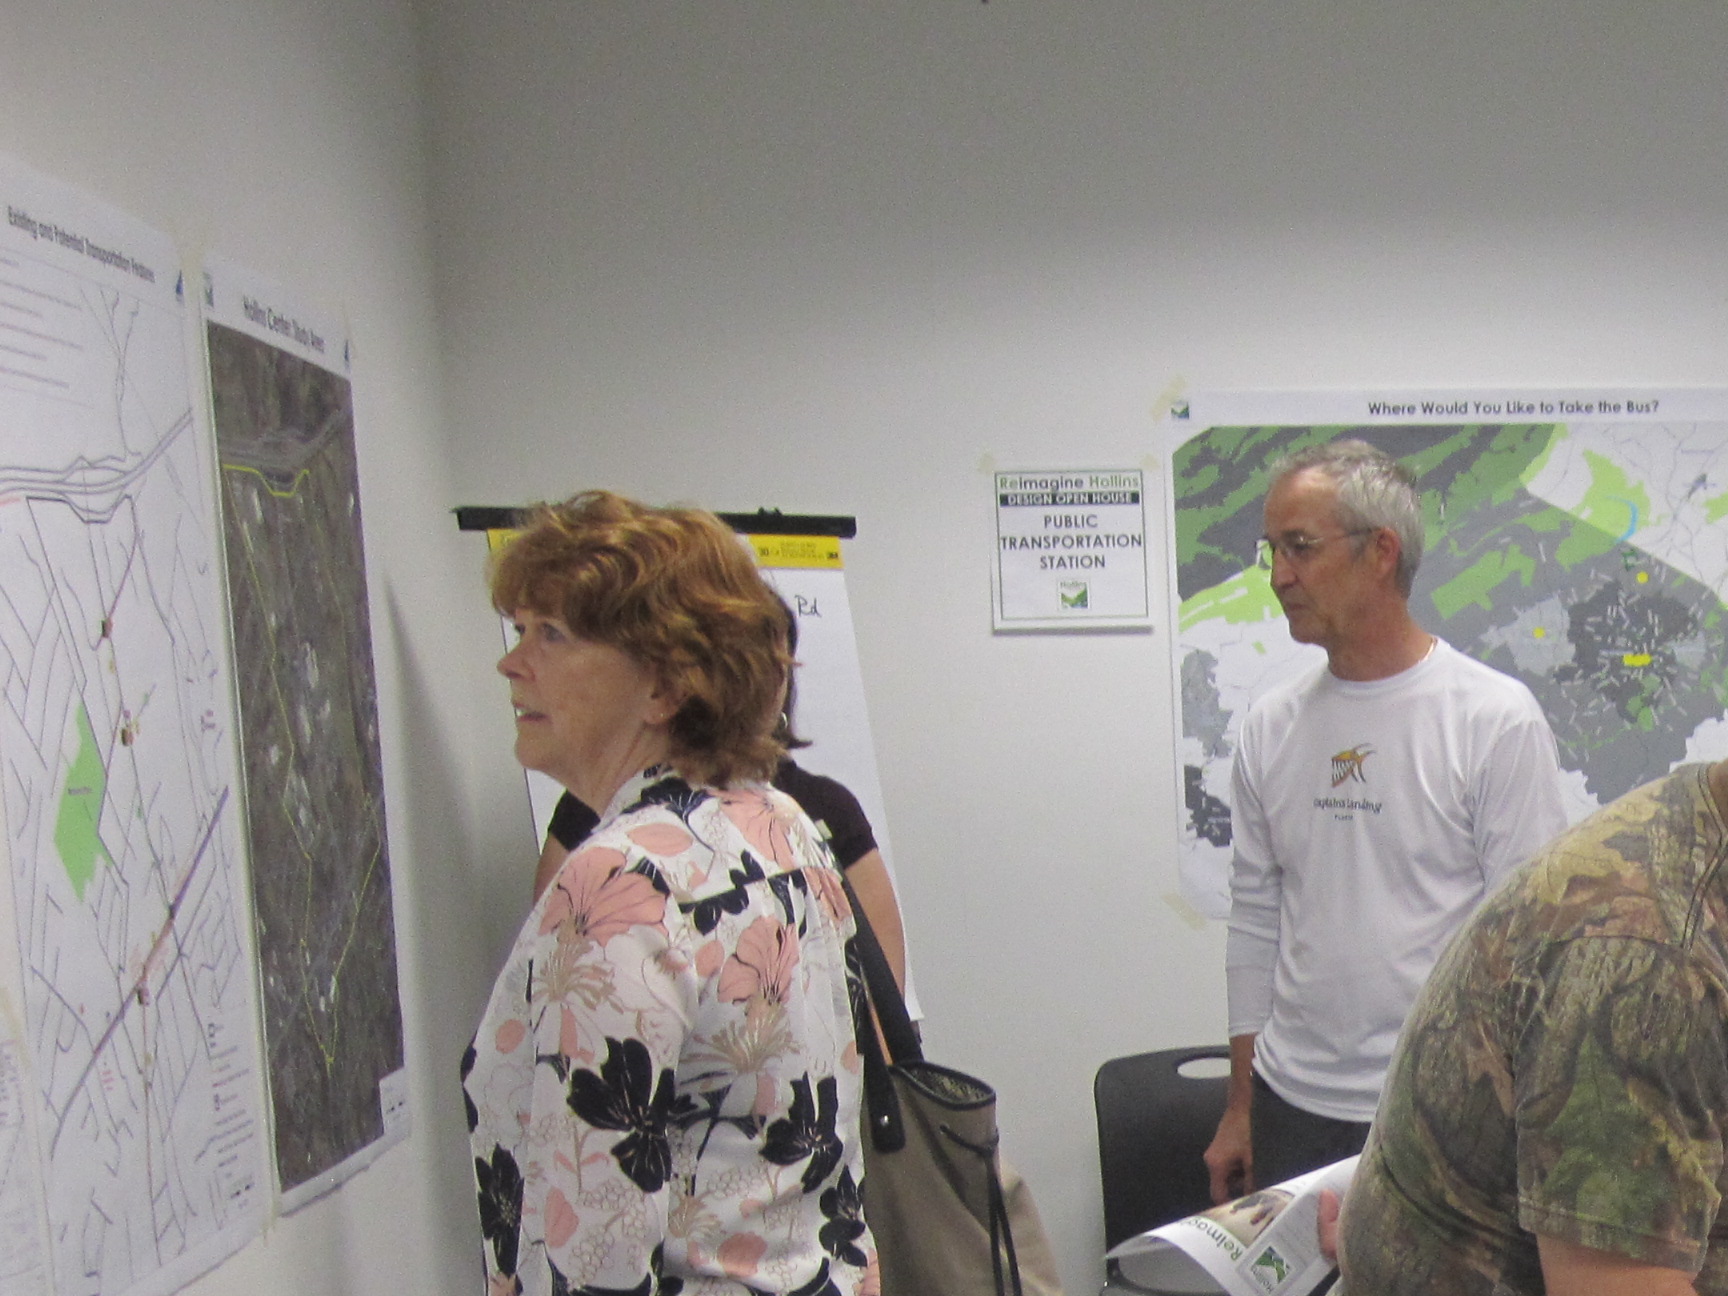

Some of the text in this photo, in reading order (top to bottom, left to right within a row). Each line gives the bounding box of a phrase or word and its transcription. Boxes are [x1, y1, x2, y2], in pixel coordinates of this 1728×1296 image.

[1368, 401, 1659, 415] Where Would You Like to Take the Bus?
[1089, 475, 1139, 488] Hollins
[1007, 492, 1132, 505] DESIGN OPEN HOUSE
[1044, 514, 1098, 529] PUBLIC
[1000, 534, 1142, 550] TRANSPORTATION
[1040, 555, 1106, 570] STATION
